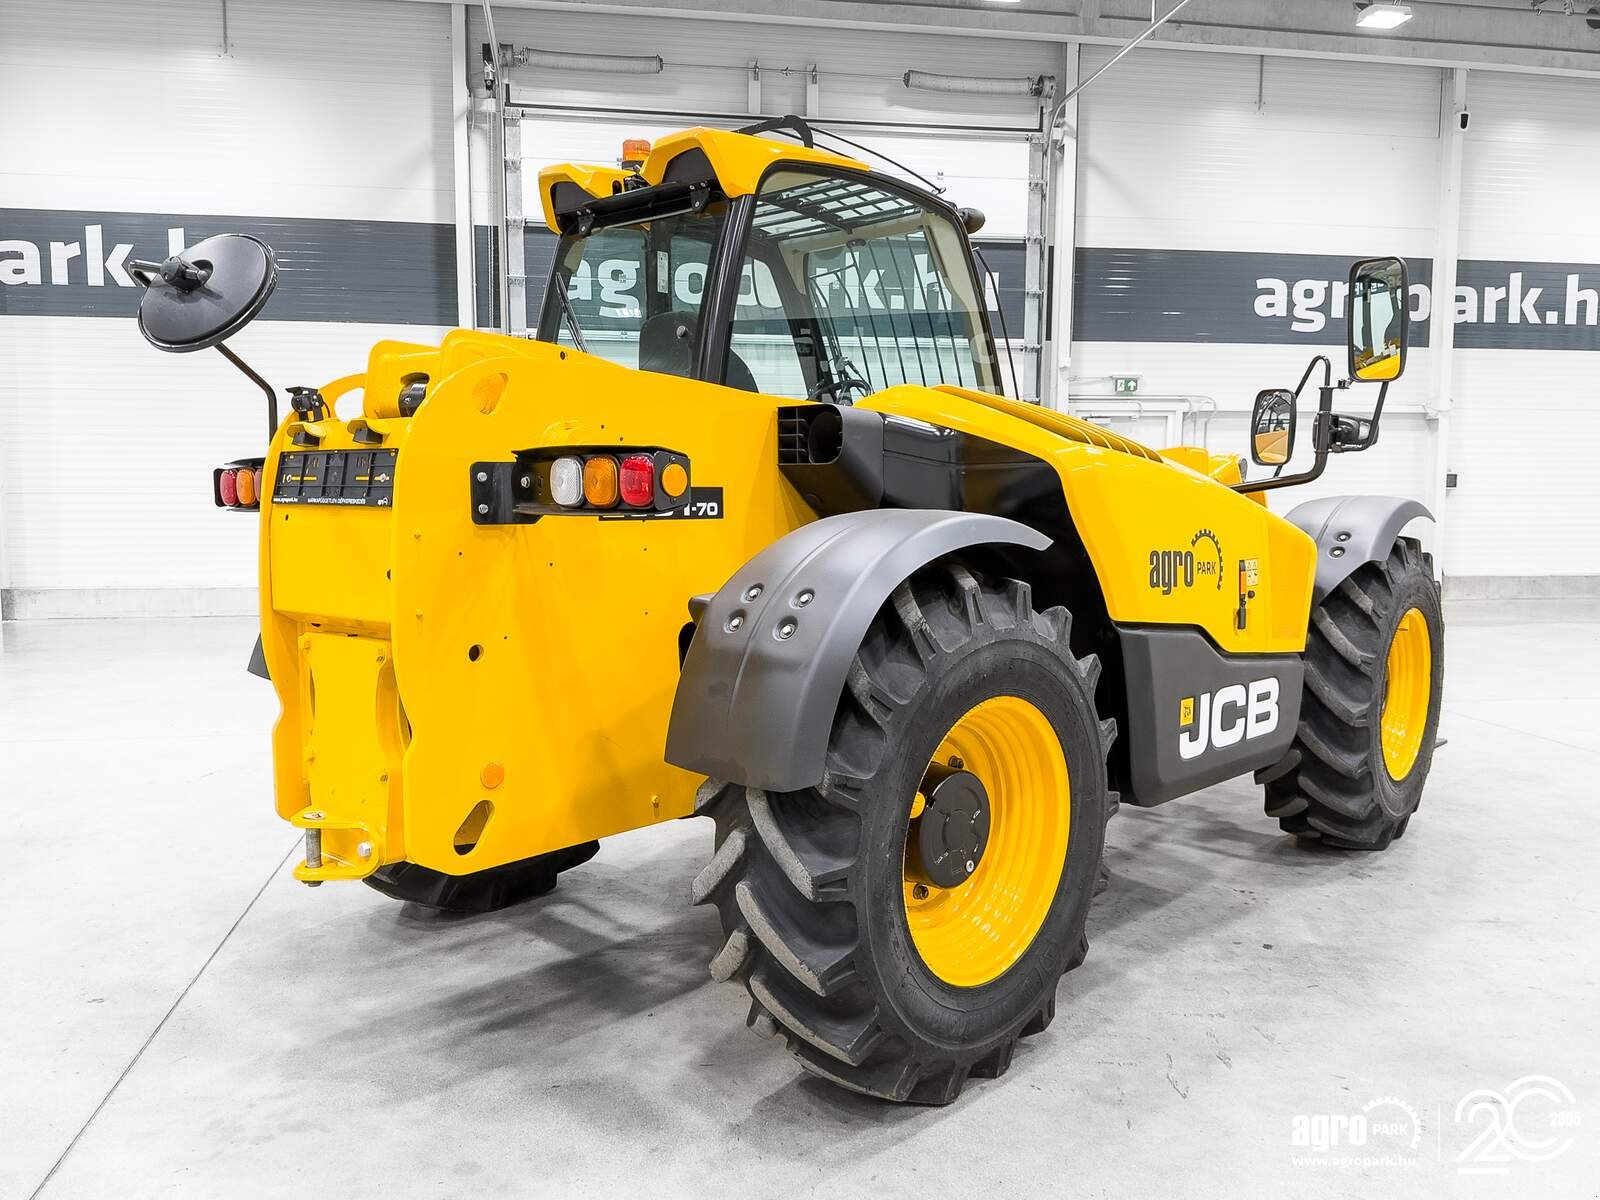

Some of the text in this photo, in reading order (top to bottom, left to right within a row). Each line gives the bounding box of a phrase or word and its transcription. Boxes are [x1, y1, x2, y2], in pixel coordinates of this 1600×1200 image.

[1149, 550, 1217, 595] agro PARK
[1179, 676, 1280, 760] JCB
